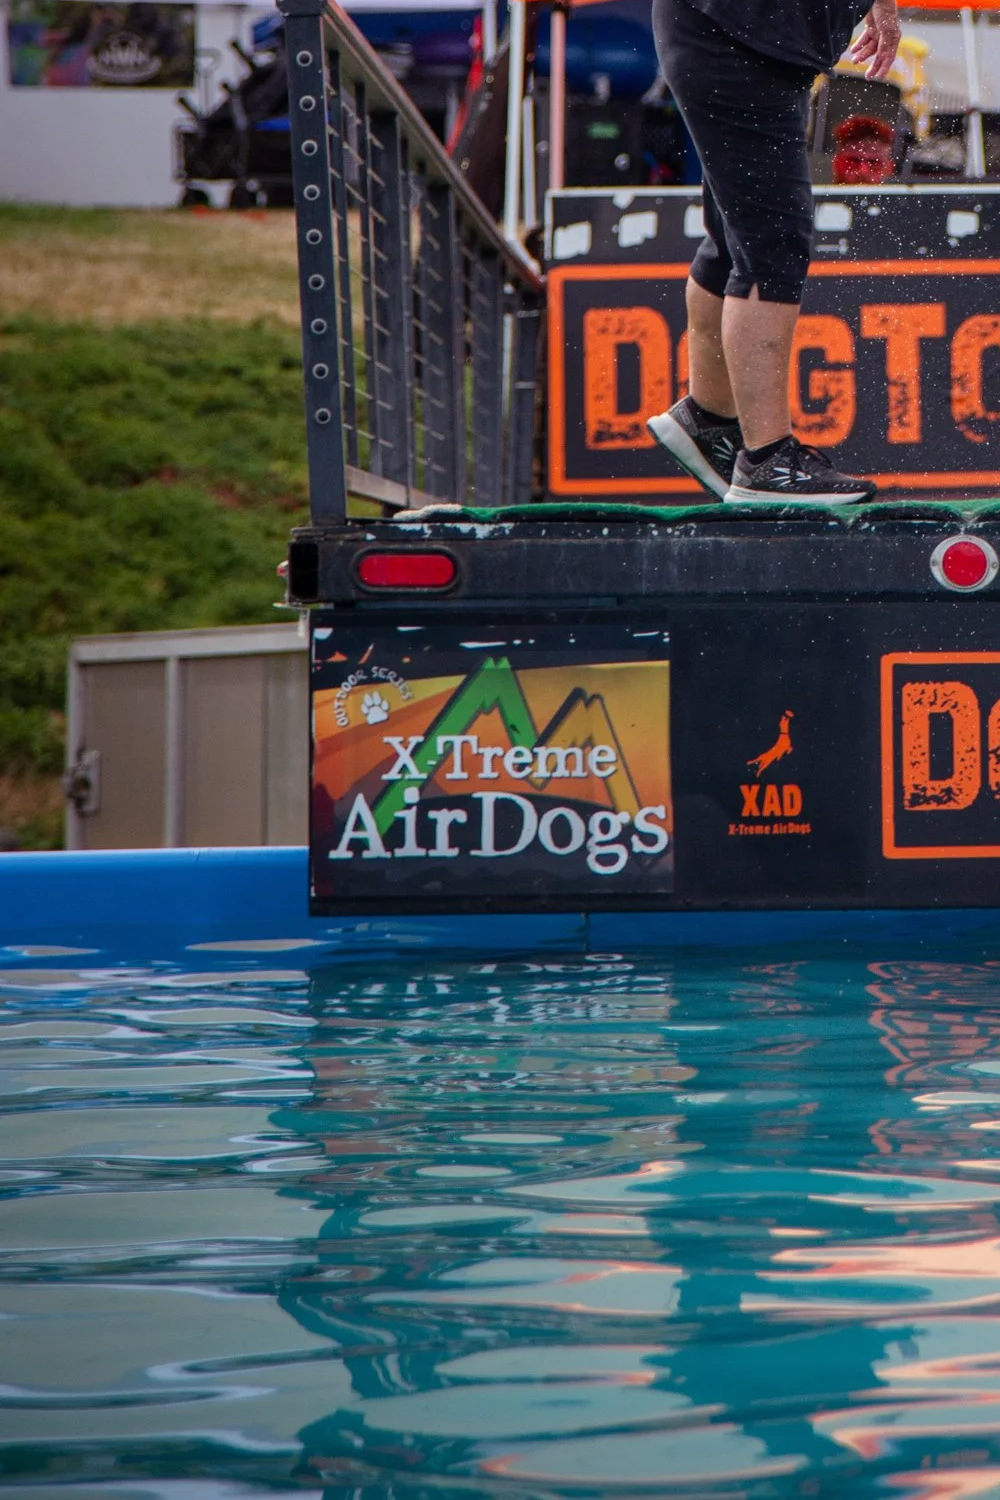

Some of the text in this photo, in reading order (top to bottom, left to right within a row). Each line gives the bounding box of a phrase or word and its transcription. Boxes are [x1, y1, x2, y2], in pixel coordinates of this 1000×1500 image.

[333, 665, 413, 727] OUTDOOR SERIES
[381, 734, 617, 781] X-Treme
[740, 784, 803, 817] XAD
[328, 786, 670, 876] AirDogs
[728, 821, 812, 836] X-Treme AirDogs
